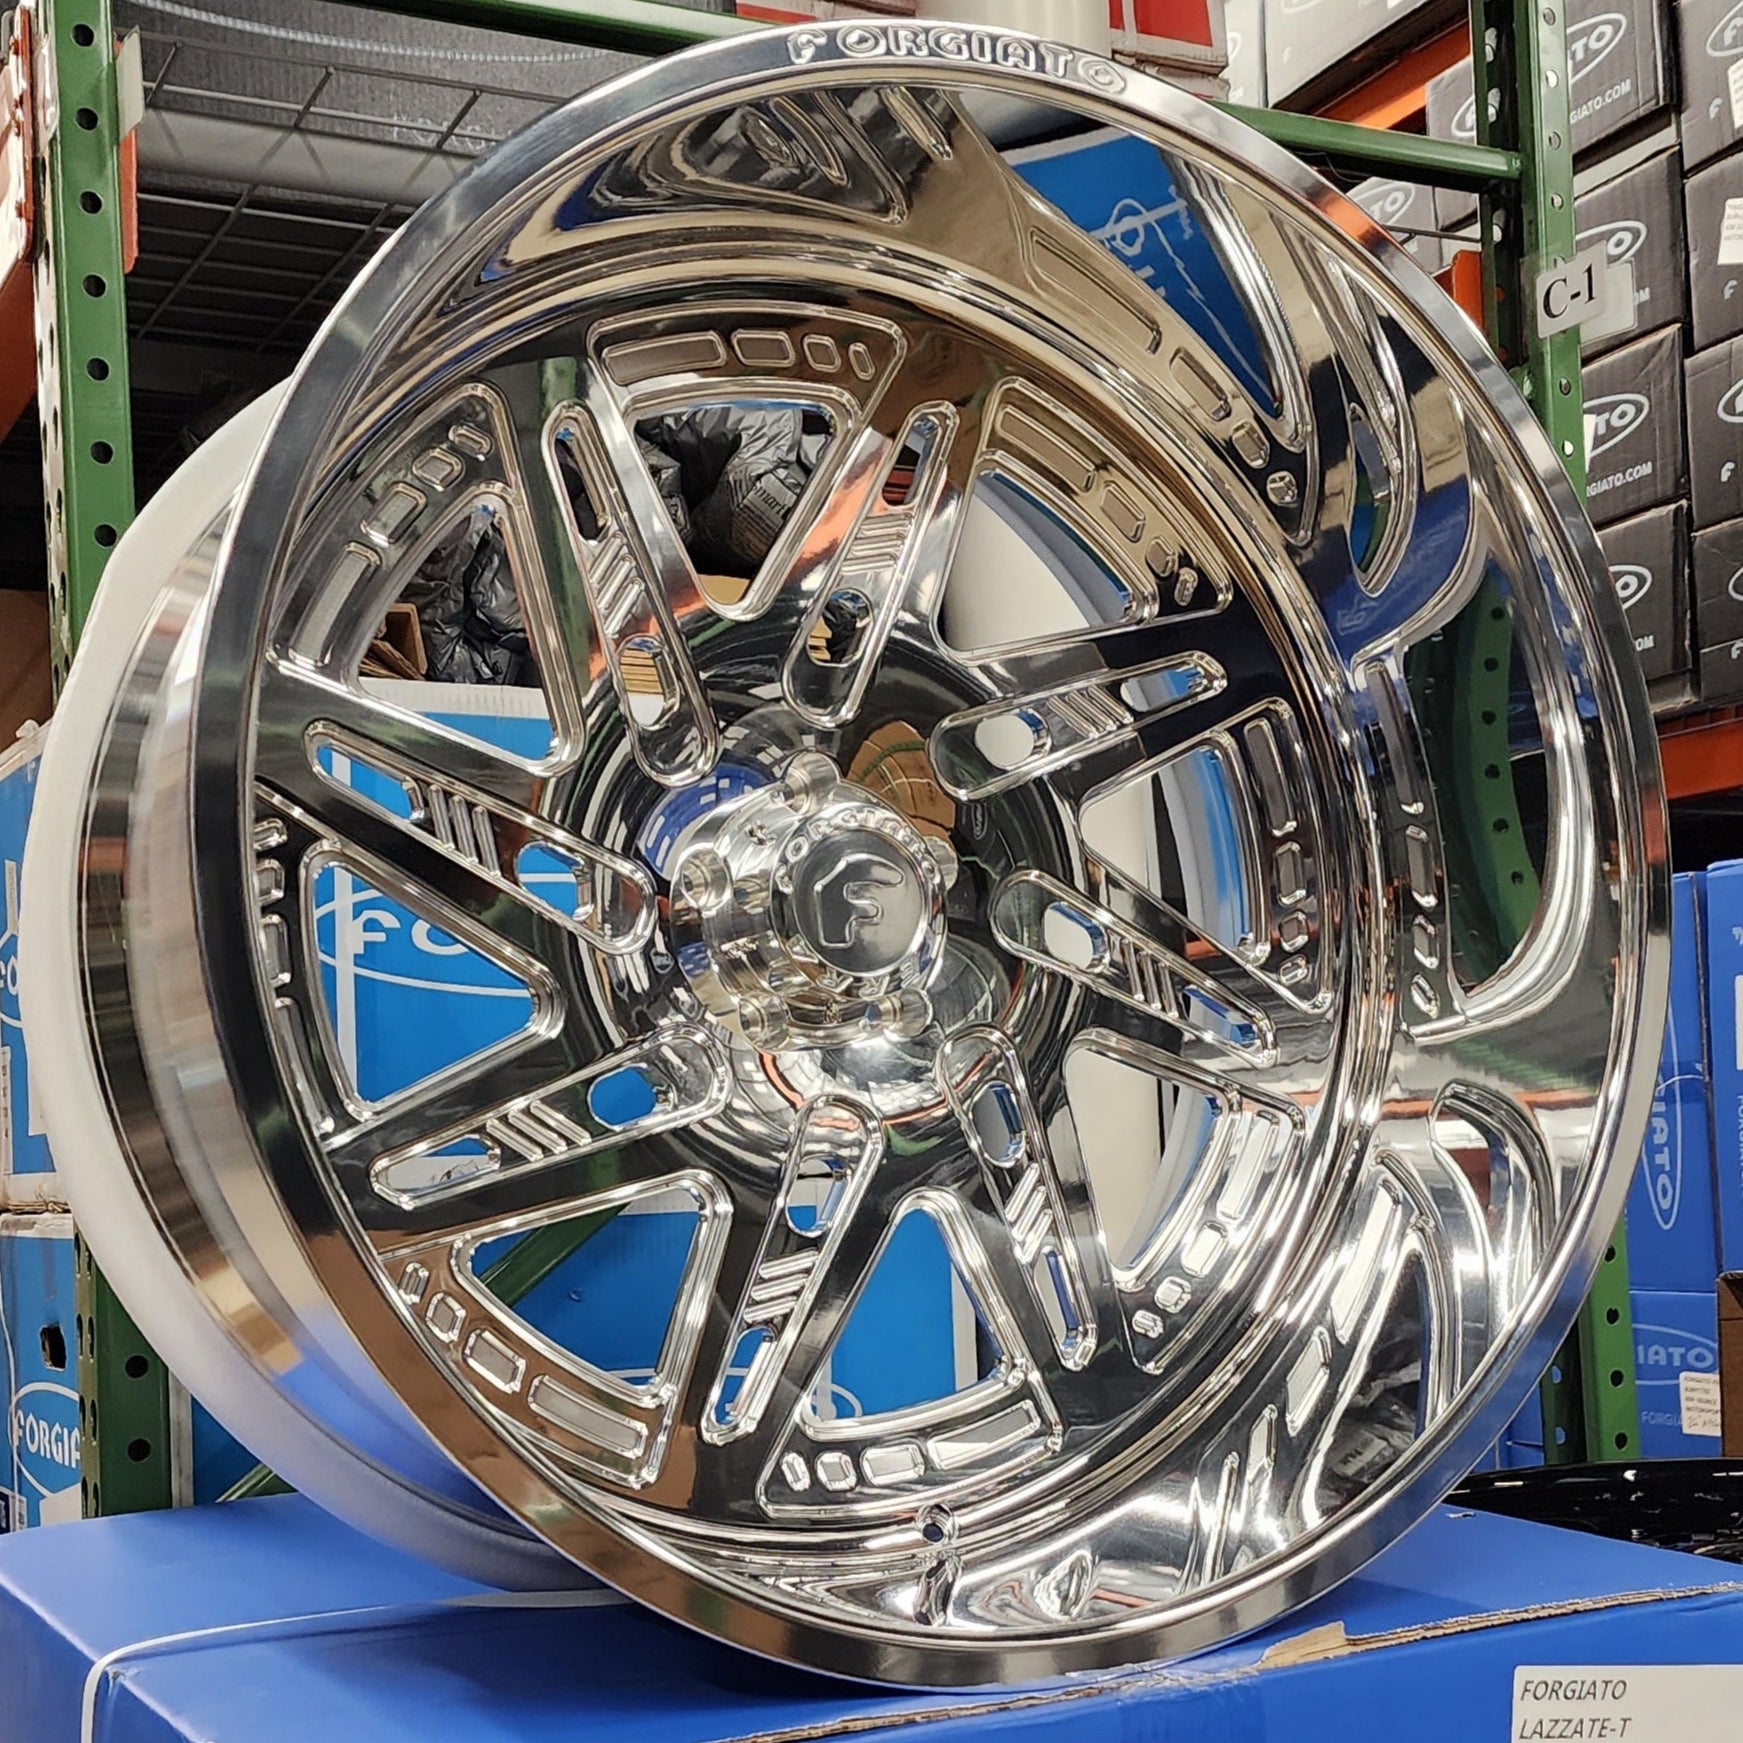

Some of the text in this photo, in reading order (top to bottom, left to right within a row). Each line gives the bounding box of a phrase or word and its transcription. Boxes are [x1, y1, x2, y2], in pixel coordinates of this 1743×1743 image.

[786, 24, 1128, 95] FORGIATO
[1543, 263, 1596, 319] C-1
[1520, 1679, 1627, 1701] FORGIATO
[1519, 1717, 1632, 1740] LAZZATE-T
